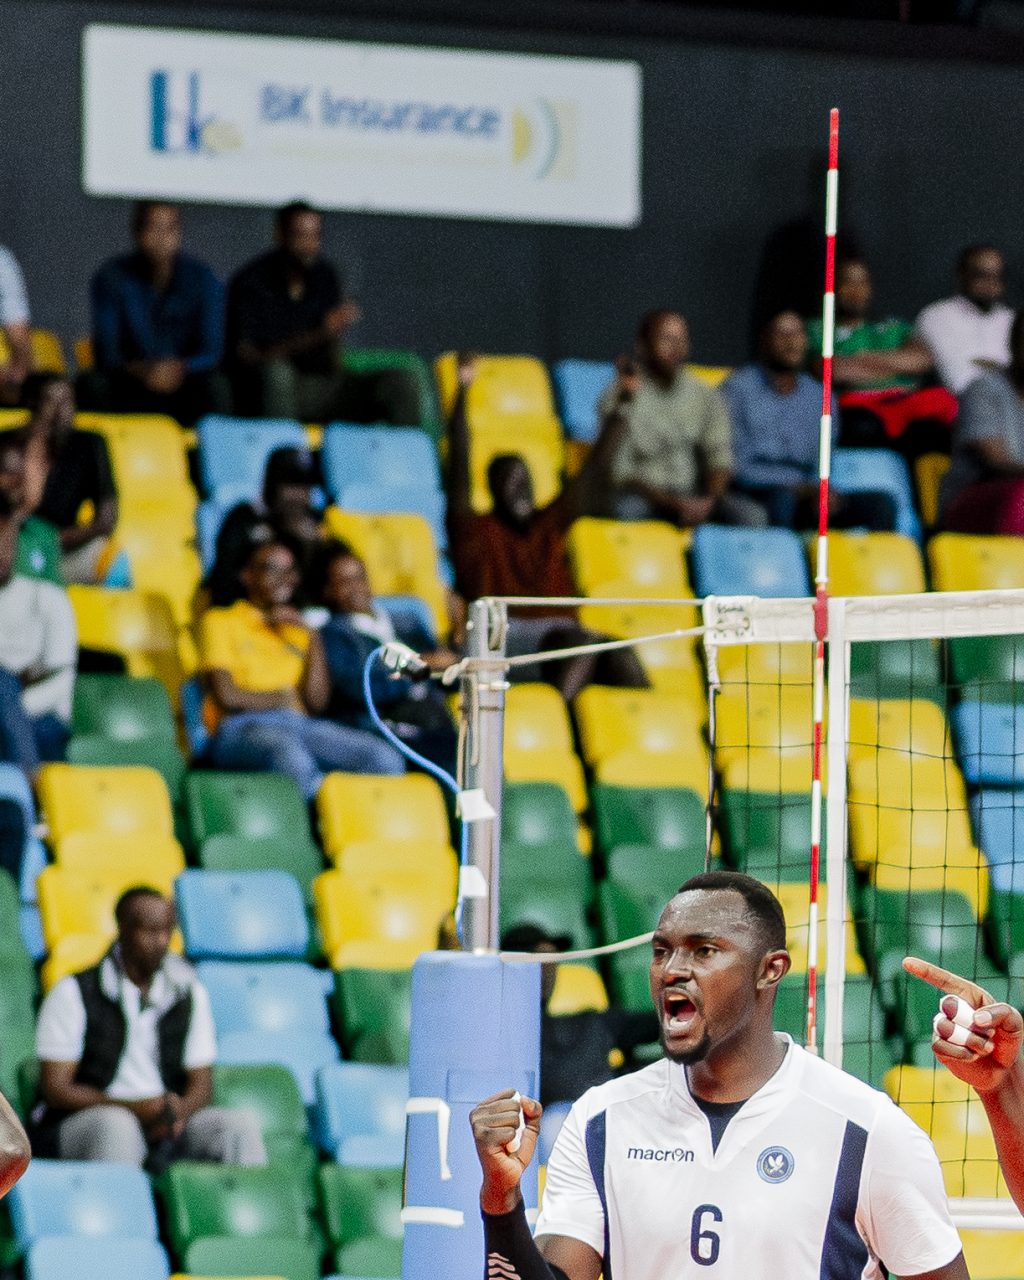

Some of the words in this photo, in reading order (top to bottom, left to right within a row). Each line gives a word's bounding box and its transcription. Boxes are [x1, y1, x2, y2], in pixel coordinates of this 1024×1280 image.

[259, 81, 311, 126] BK
[318, 84, 500, 138] Insurance
[627, 1147, 695, 1163] macron
[690, 1203, 724, 1267] 6
